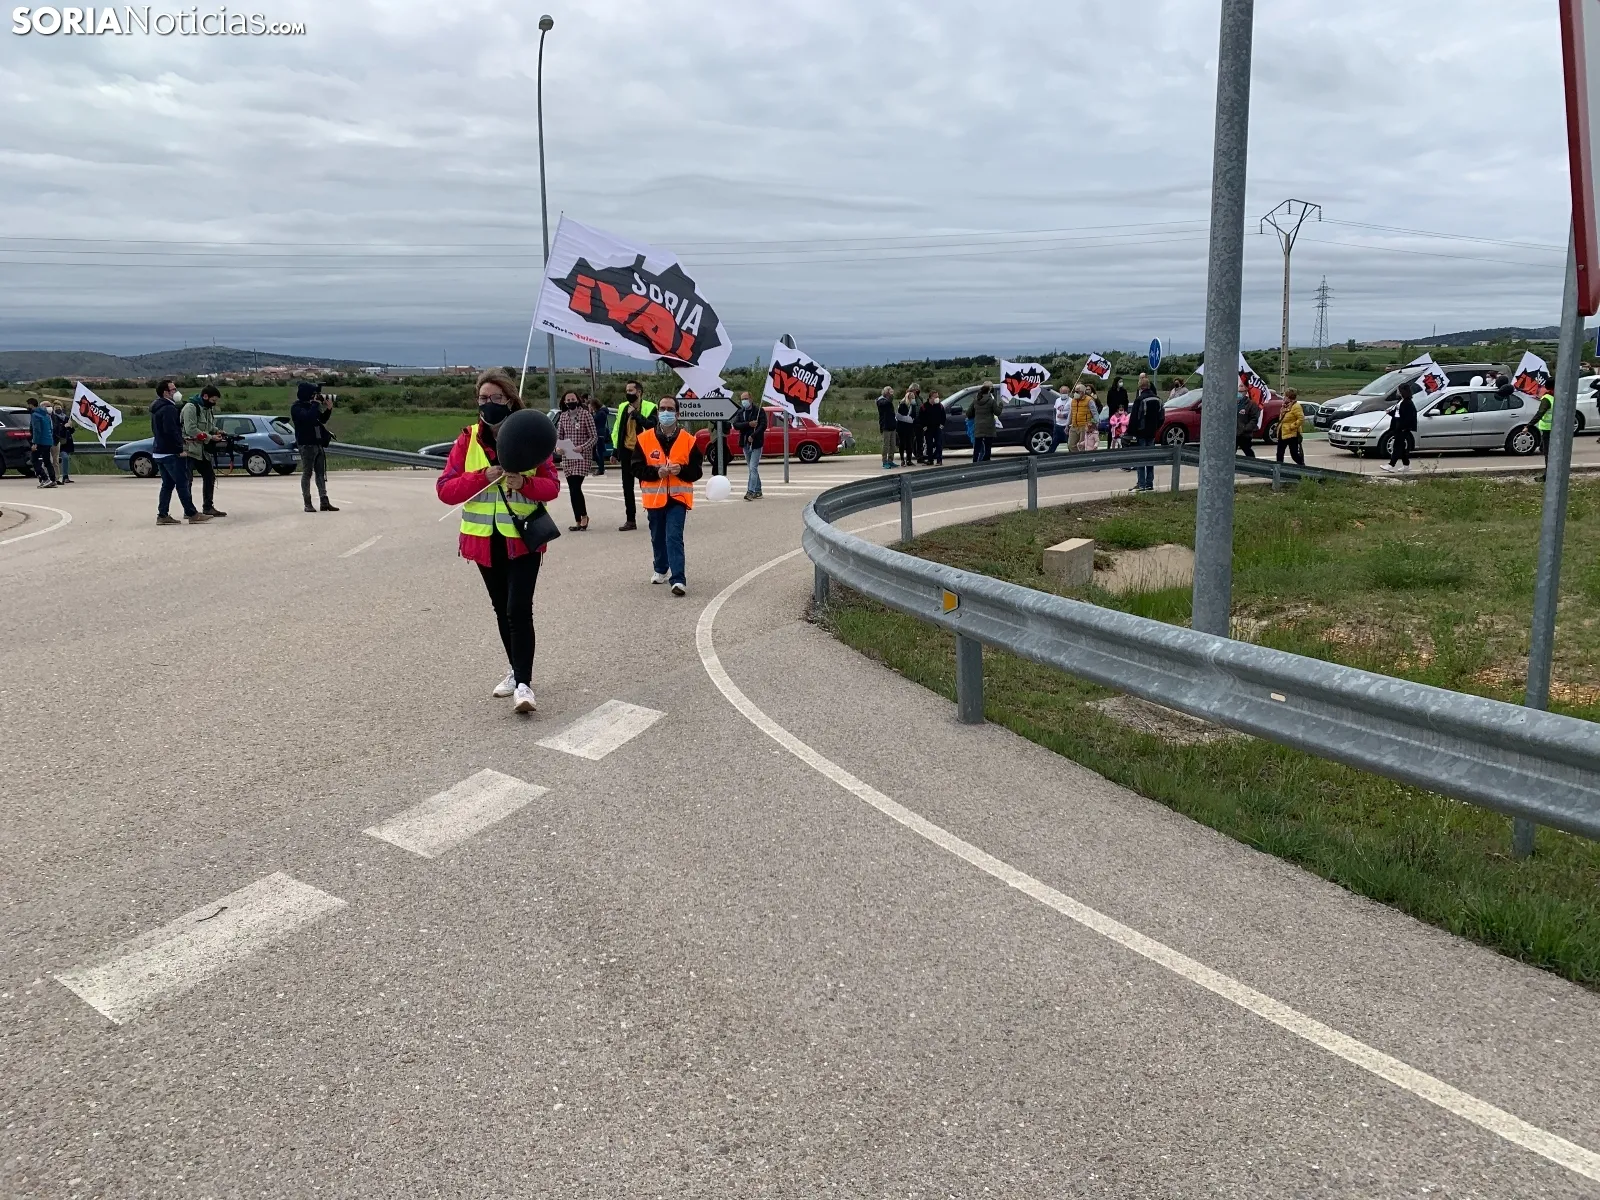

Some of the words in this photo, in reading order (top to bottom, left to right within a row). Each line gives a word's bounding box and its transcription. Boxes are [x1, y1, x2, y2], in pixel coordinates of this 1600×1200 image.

[569, 273, 697, 361] ¡YA!
[631, 271, 704, 336] SORIA
[773, 367, 816, 404] ¡YA!
[792, 365, 819, 388] SORIA
[680, 410, 724, 418] direcciones
